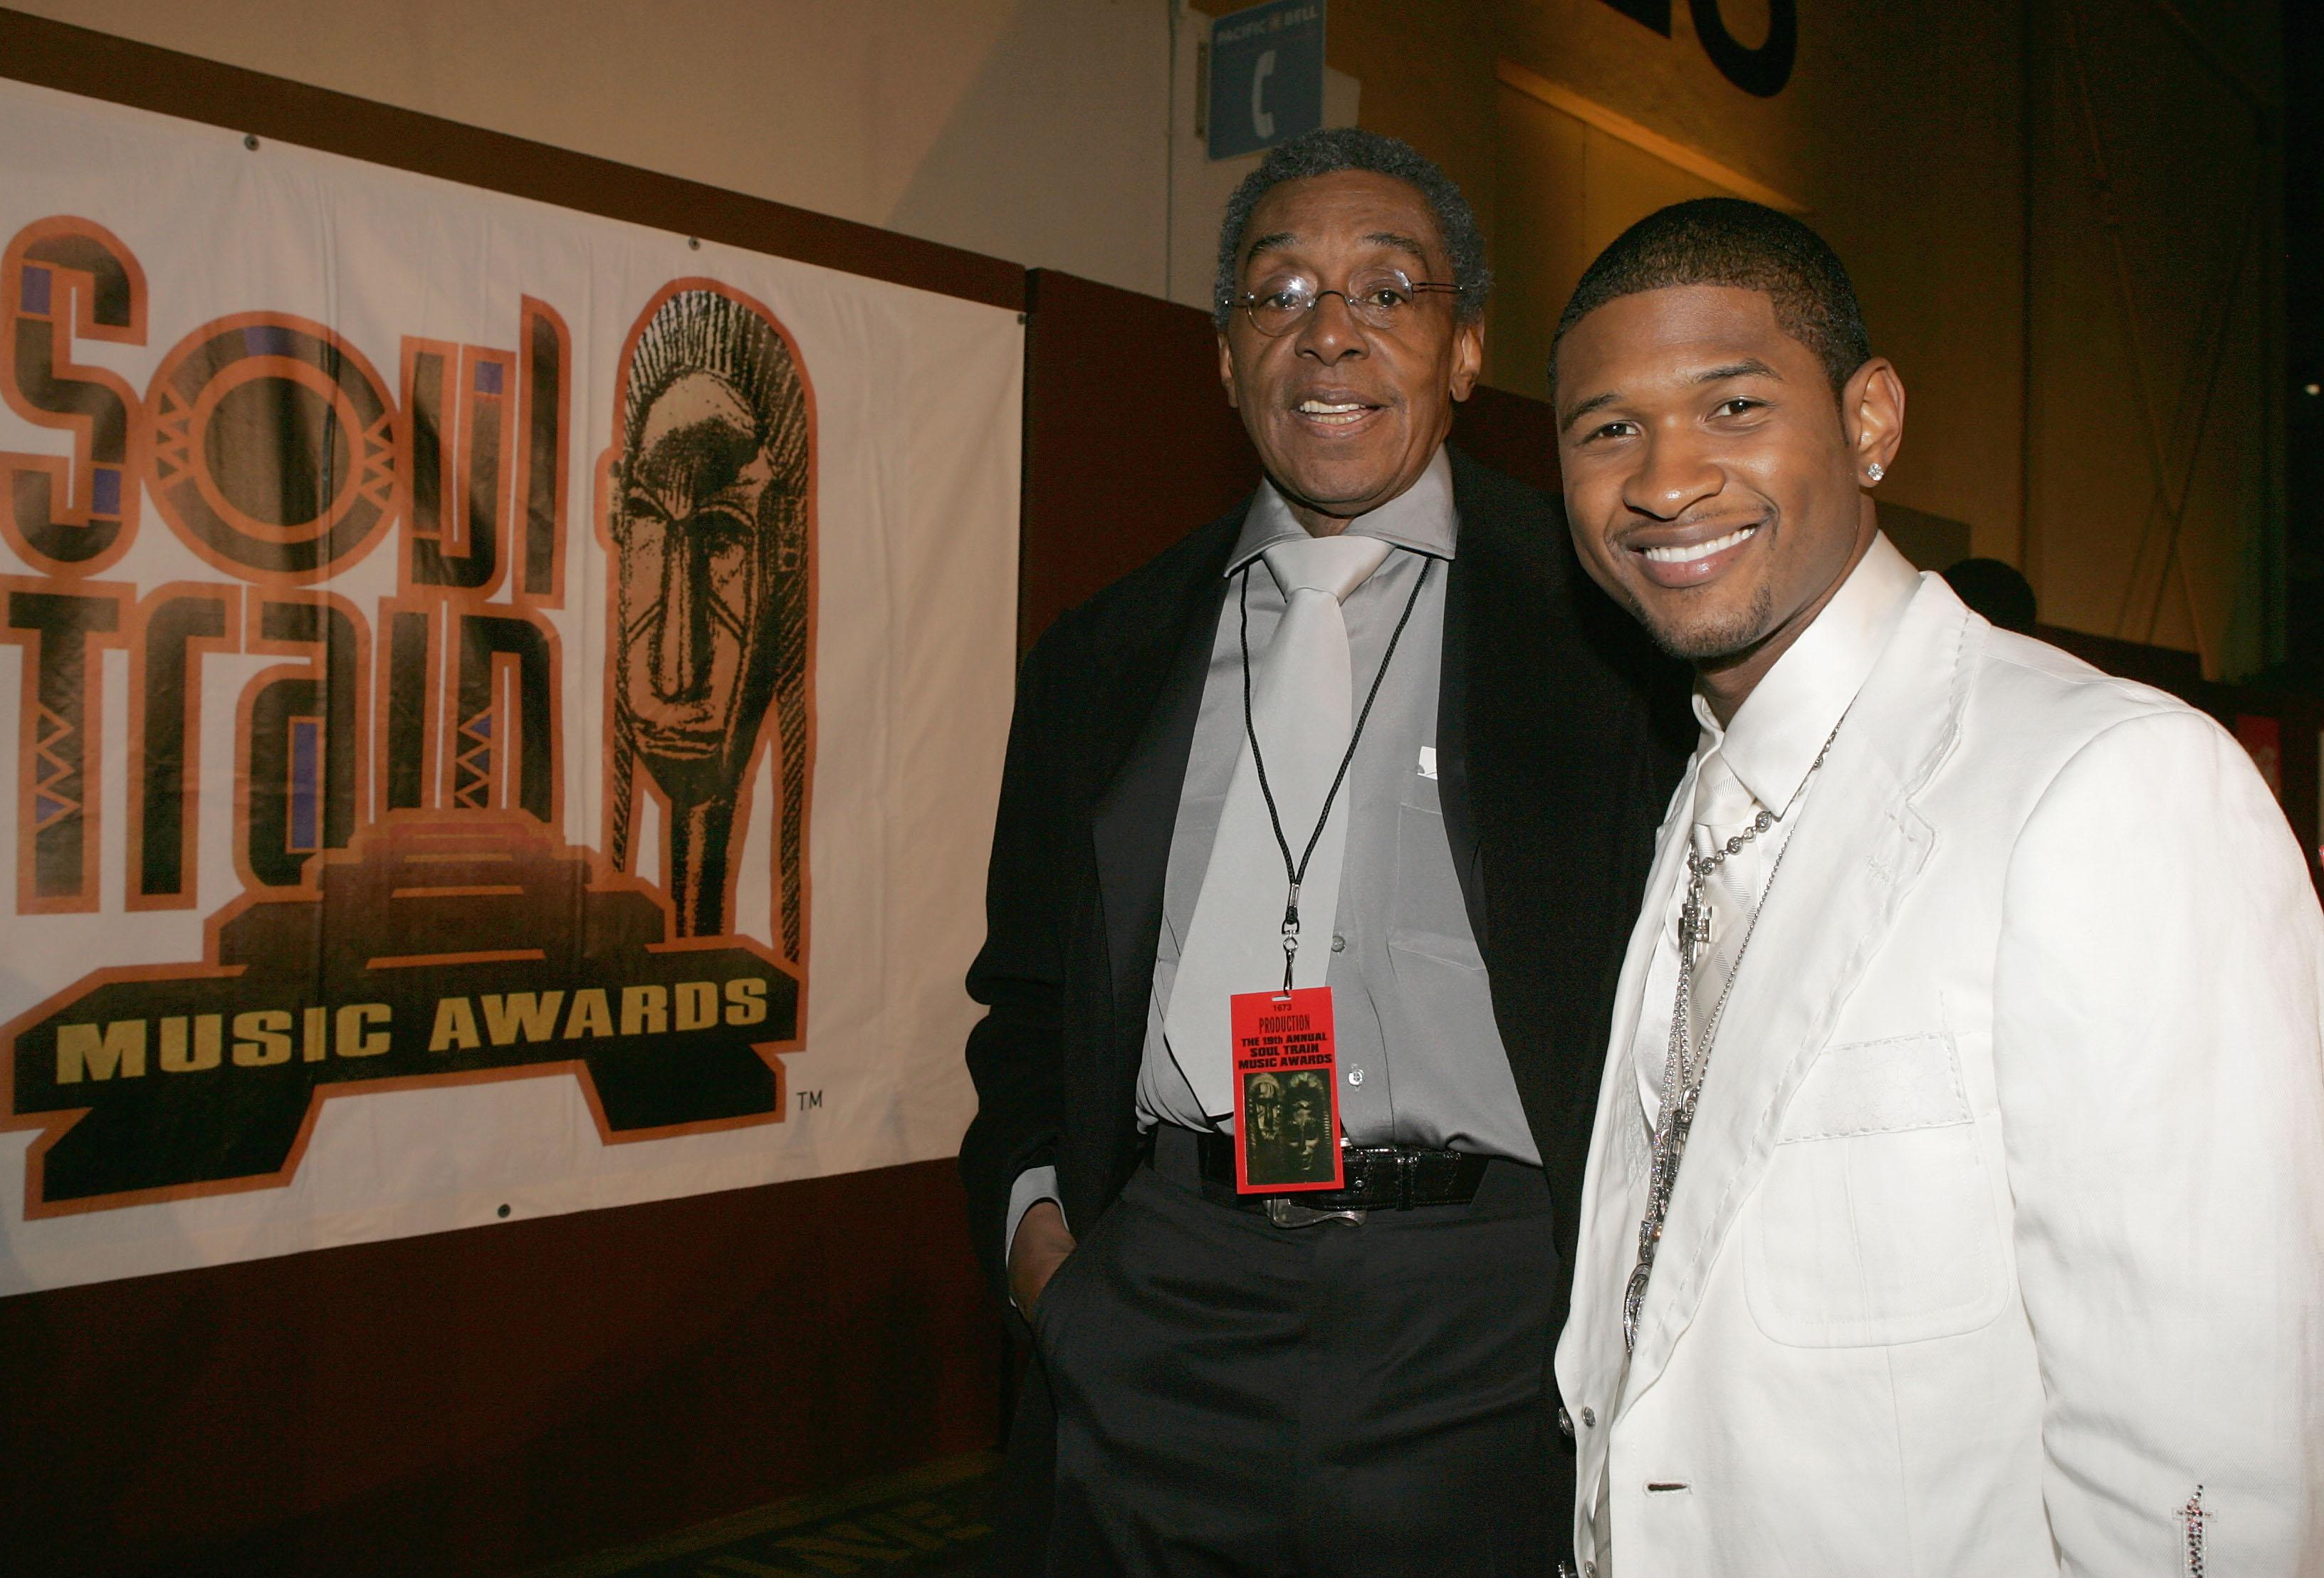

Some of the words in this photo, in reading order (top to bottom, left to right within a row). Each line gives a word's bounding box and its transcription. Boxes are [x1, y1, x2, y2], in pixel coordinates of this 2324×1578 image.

[56, 1003, 392, 1085] MUSIC
[428, 978, 768, 1052] AWARDS
[1259, 1014, 1310, 1033] PRODUCTION
[1242, 1038, 1260, 1047] THE
[1263, 1035, 1283, 1045] 19th
[1286, 1033, 1327, 1043] ANNUAL
[1250, 1047, 1279, 1057] SOUL
[1284, 1044, 1319, 1055] TRAIN
[1238, 1057, 1277, 1070] MUSIC
[1280, 1054, 1332, 1066] AWARDS
